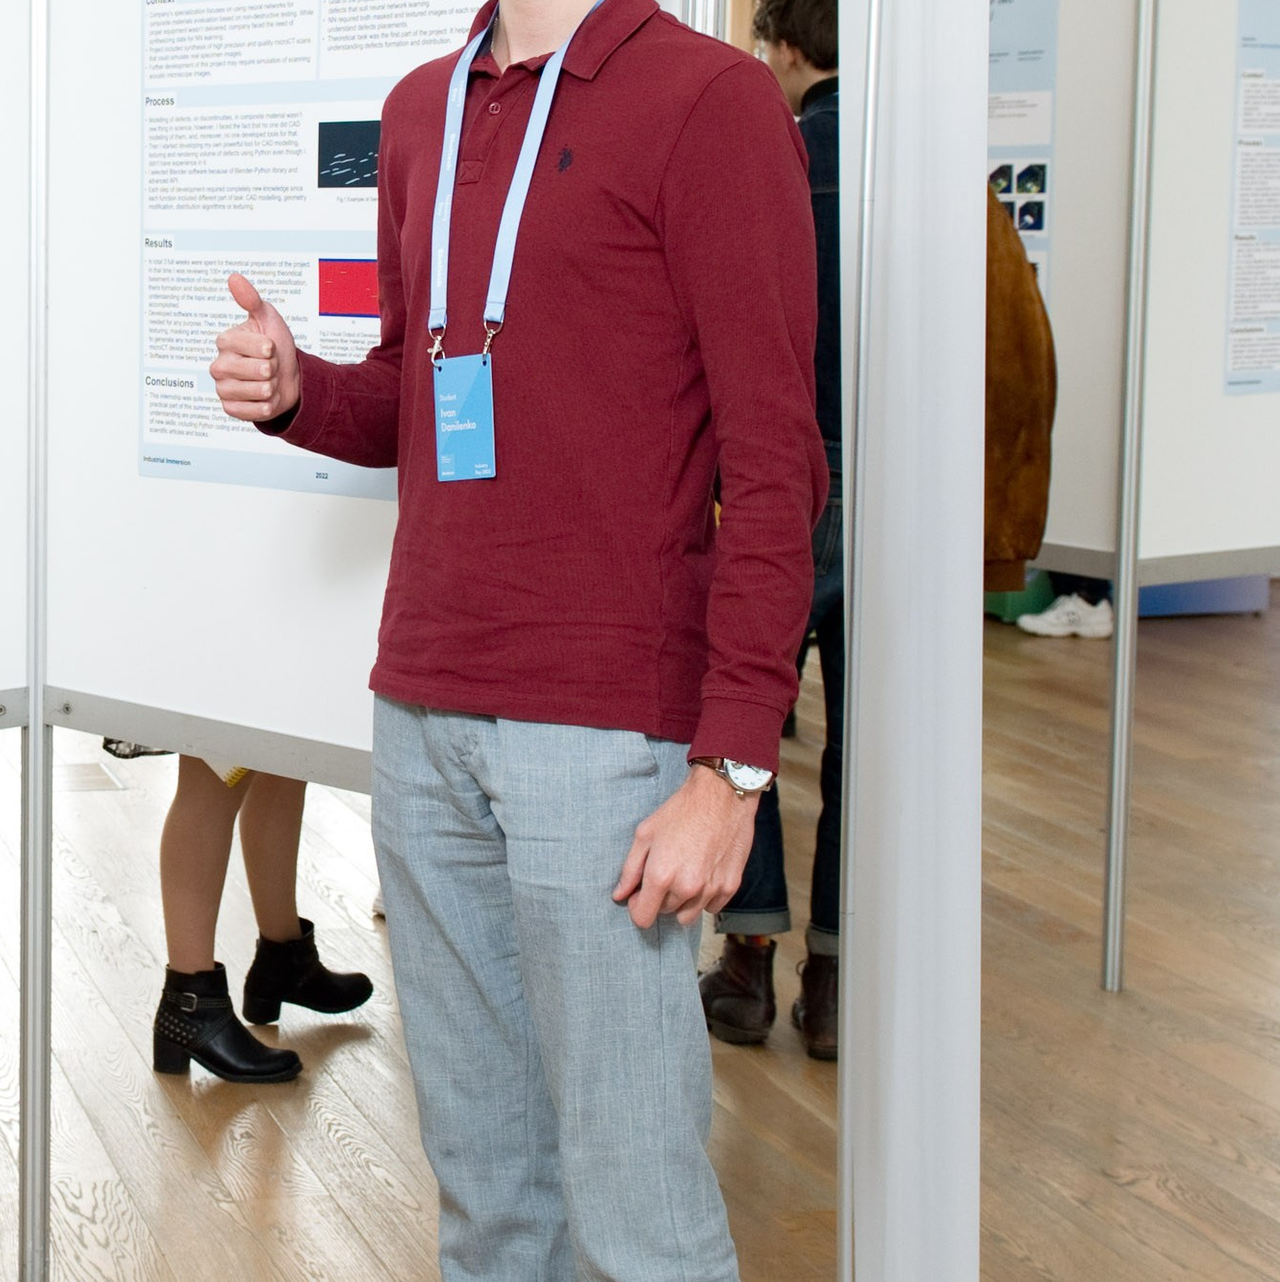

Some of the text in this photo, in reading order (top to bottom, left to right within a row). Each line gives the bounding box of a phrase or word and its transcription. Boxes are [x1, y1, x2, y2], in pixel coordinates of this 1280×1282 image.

[146, 97, 174, 106] Process
[145, 238, 172, 248] Results
[145, 376, 194, 388] Conclusions
[440, 408, 456, 418] Ivan
[441, 419, 477, 432] Danilenko
[143, 455, 191, 466] Industrial Immersion
